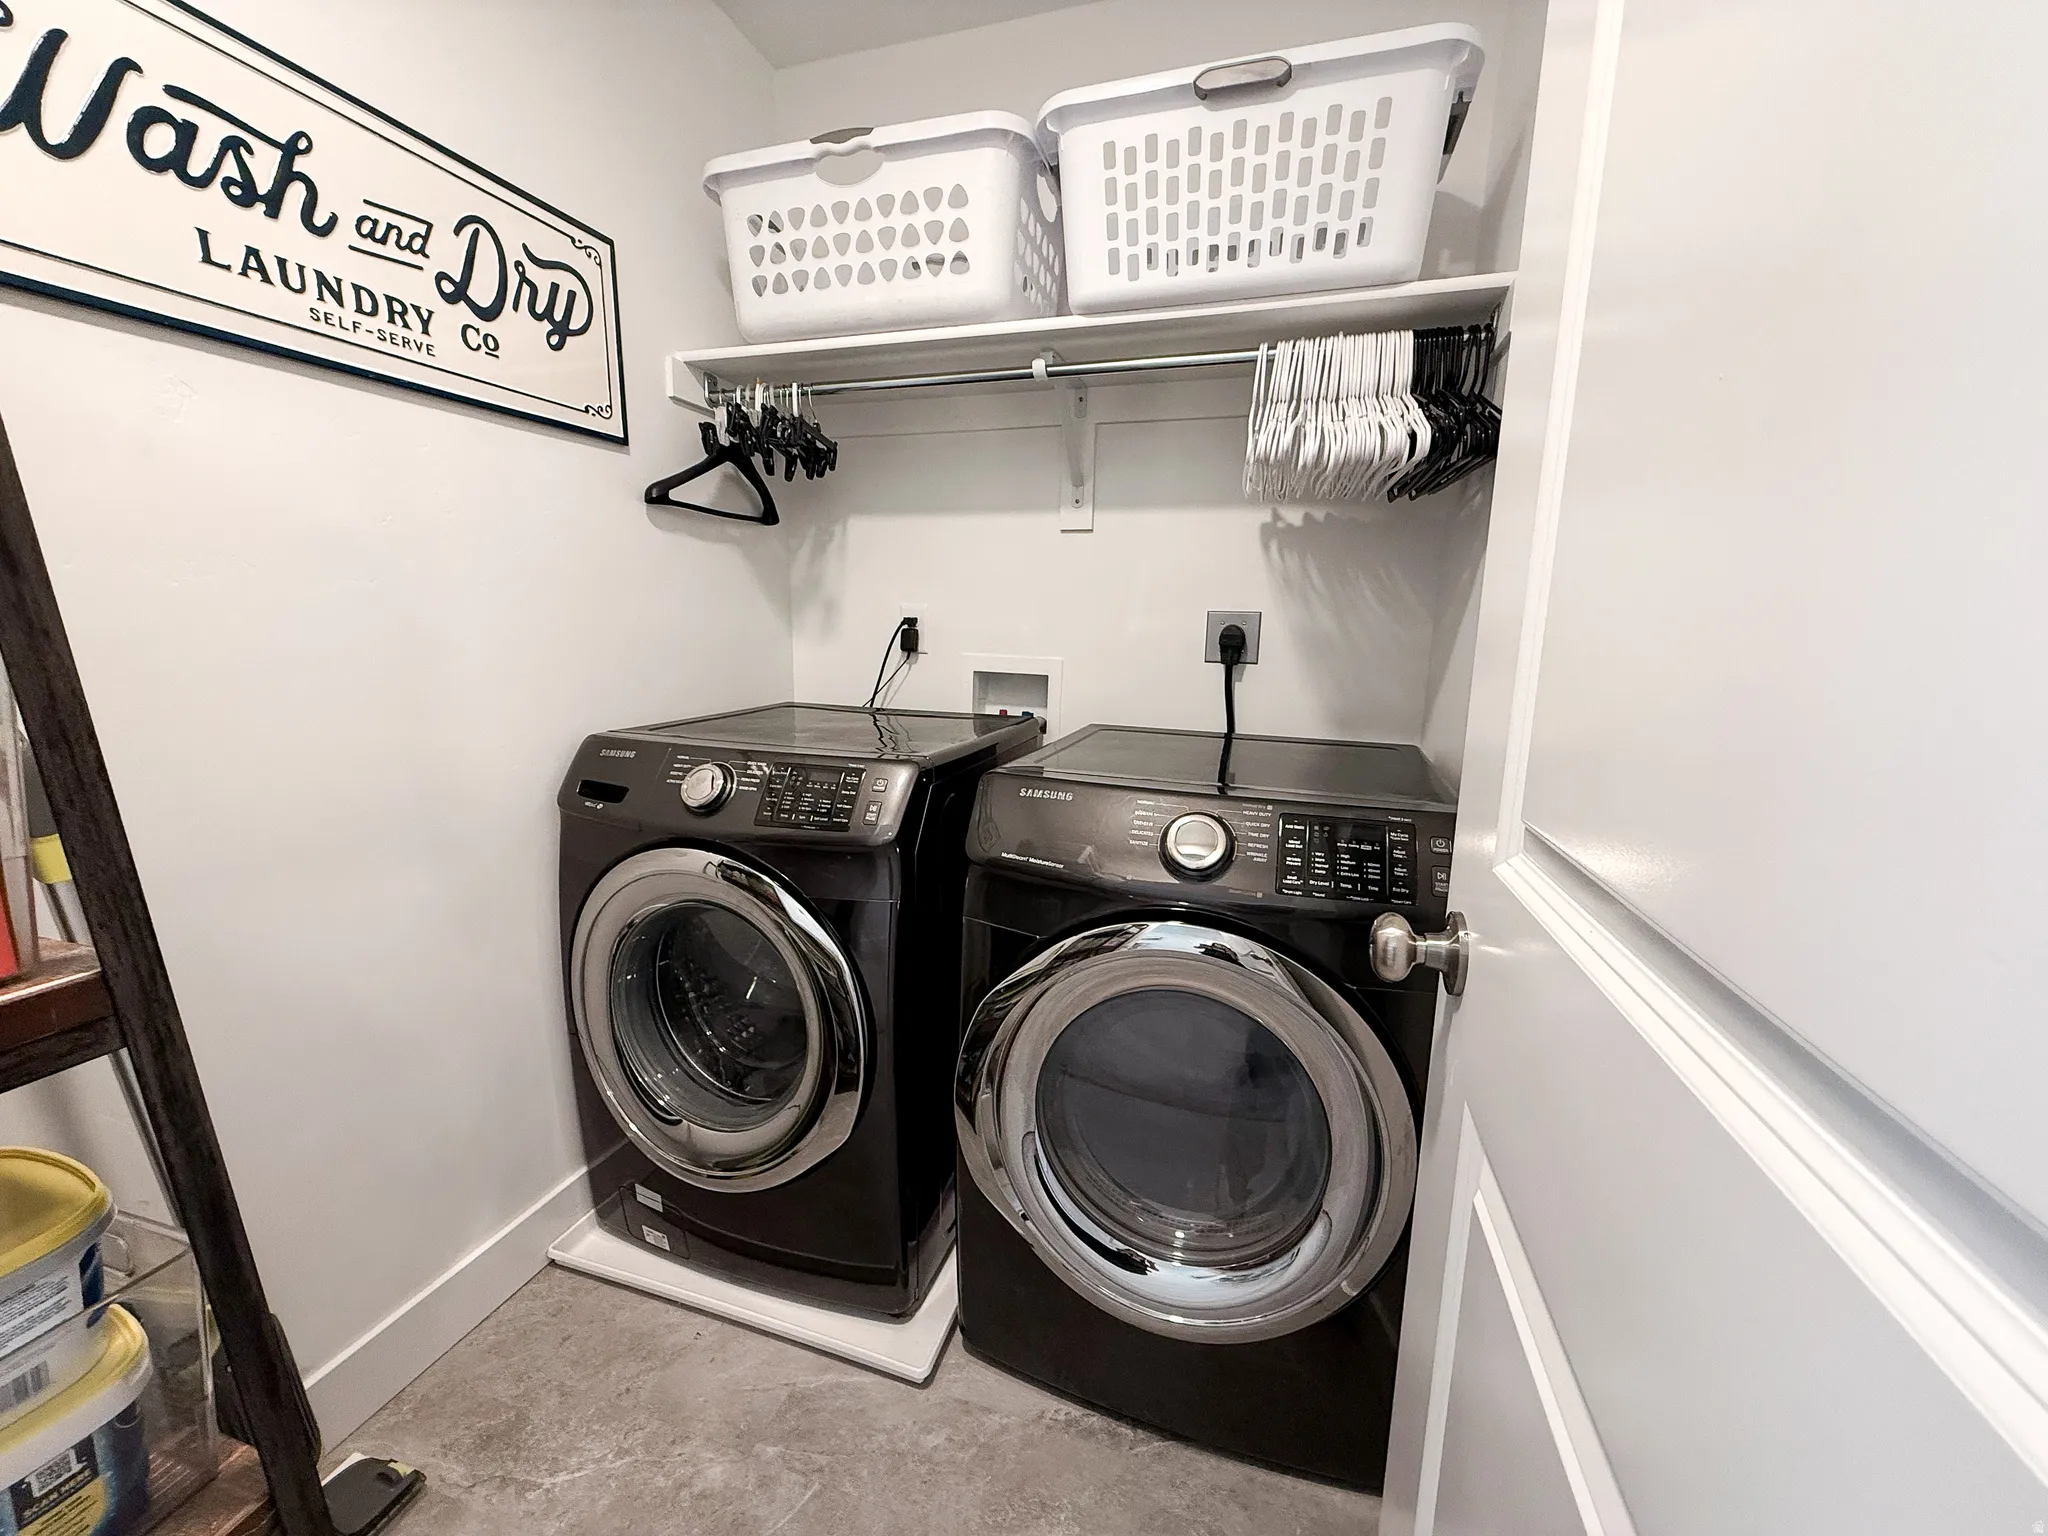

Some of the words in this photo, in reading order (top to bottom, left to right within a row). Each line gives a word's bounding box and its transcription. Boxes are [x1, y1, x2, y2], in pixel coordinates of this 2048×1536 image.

[0, 0, 339, 237] Wash
[354, 212, 432, 259] and
[435, 214, 595, 352] Dry
[193, 227, 434, 336] LAUNDRY
[309, 307, 436, 357] SELF-SERVE
[599, 749, 637, 759] SAMSUNG
[1019, 788, 1074, 801] SAMSUNG
